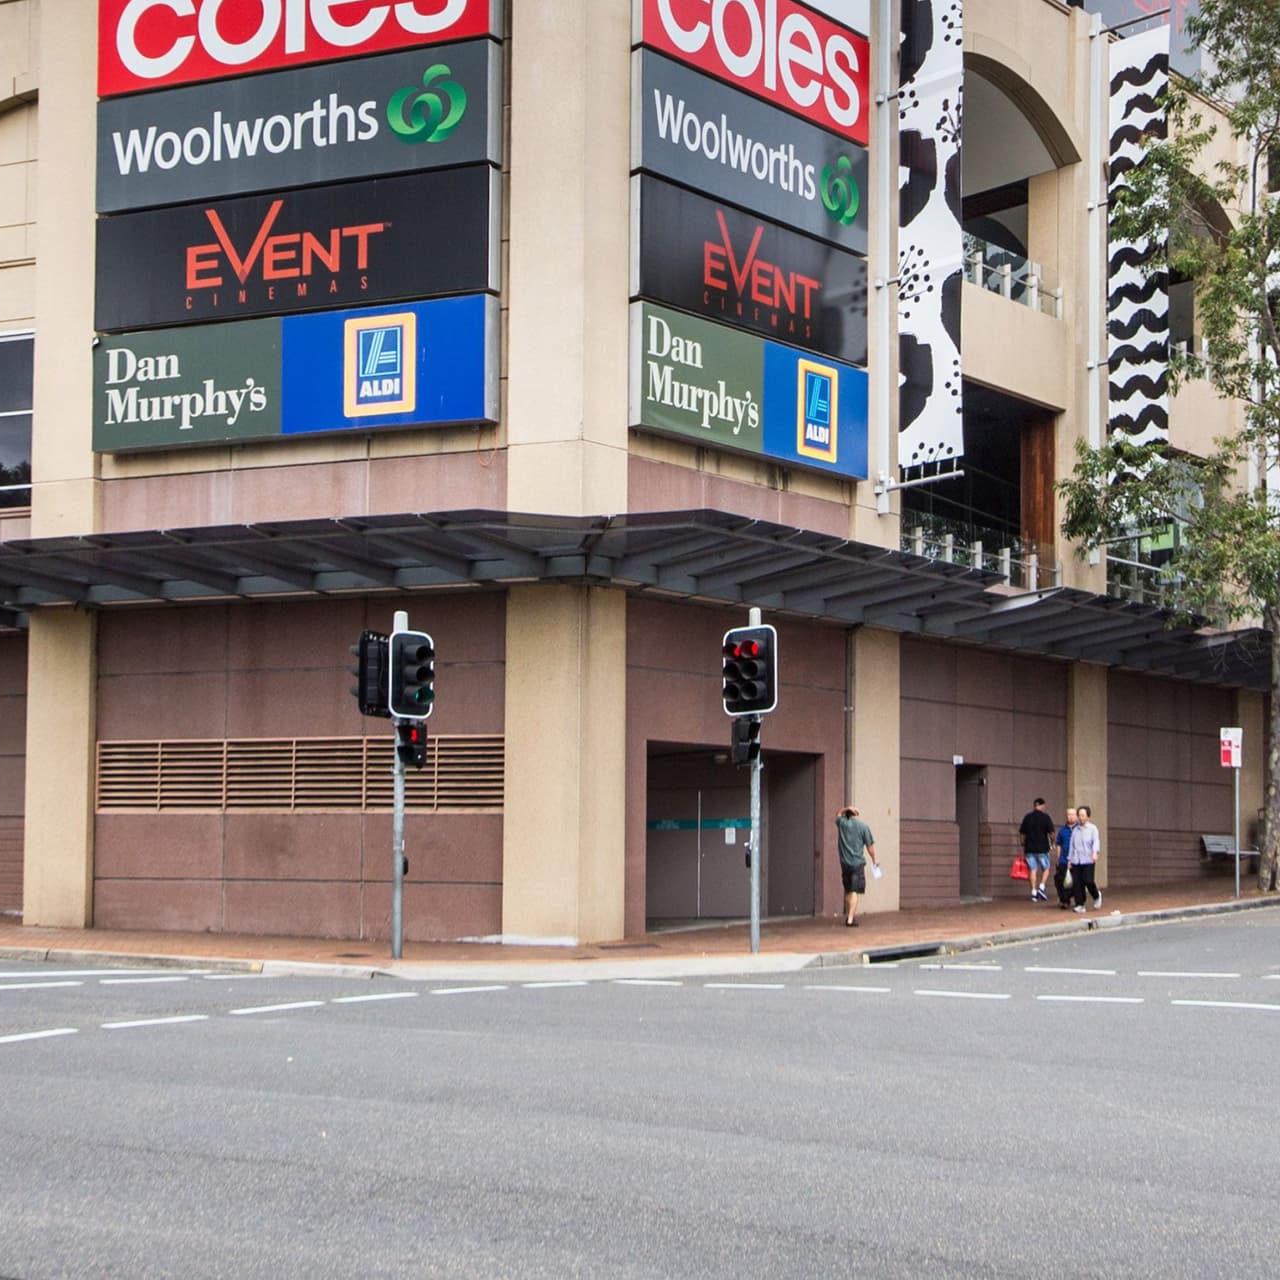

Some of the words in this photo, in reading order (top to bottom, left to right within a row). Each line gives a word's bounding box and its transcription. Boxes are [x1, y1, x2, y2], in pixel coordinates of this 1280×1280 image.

[113, 93, 378, 176] Woolworths
[654, 89, 816, 202] Woolworths
[186, 199, 384, 290] EVENT
[704, 208, 820, 319] EVENT
[184, 276, 368, 310] CINEMAS
[704, 290, 812, 338] CINEMAS
[105, 348, 181, 385] Dan
[648, 315, 703, 368] Dan
[104, 378, 267, 430] Murphy's
[359, 379, 401, 398] ALDI
[647, 360, 759, 435] Murphy's
[806, 423, 829, 444] ALDI
